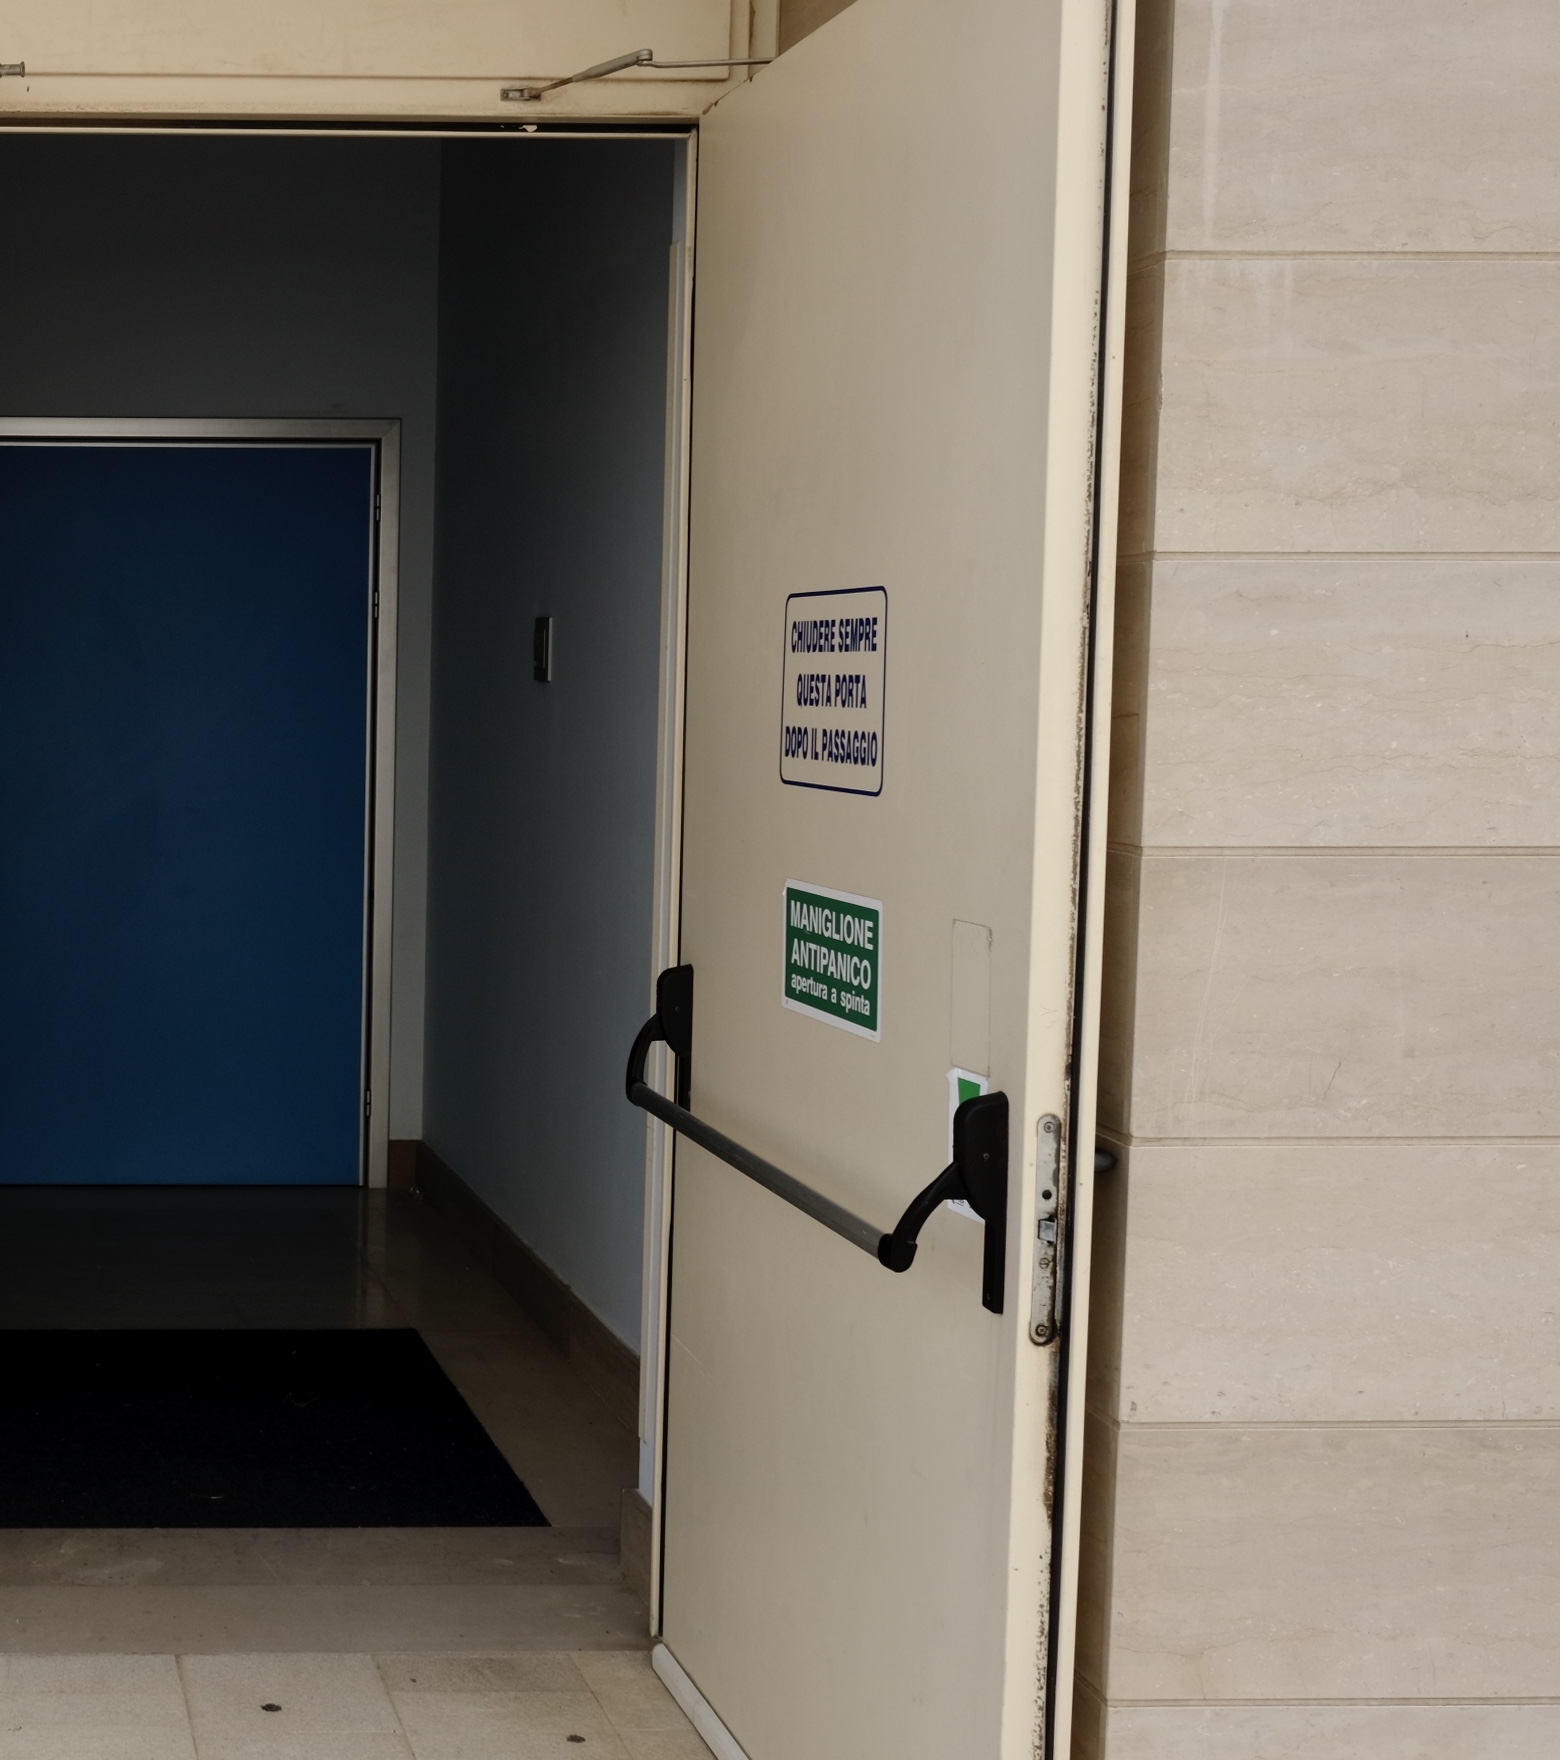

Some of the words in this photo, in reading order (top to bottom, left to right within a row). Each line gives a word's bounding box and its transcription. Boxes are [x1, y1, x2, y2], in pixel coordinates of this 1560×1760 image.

[791, 619, 836, 653] CHIUDERE
[838, 617, 878, 653] SEMPRE
[796, 673, 832, 708] QUESTA
[834, 674, 867, 709] PORTA
[785, 725, 809, 760] DOPO
[811, 728, 819, 761] IL
[821, 728, 878, 767] PASSAGGIO
[790, 899, 874, 951] MANIGLIONE
[791, 938, 872, 990] ANTIPANICO
[791, 973, 828, 1000] apertura
[831, 987, 837, 1004] a
[840, 990, 870, 1016] spinta
